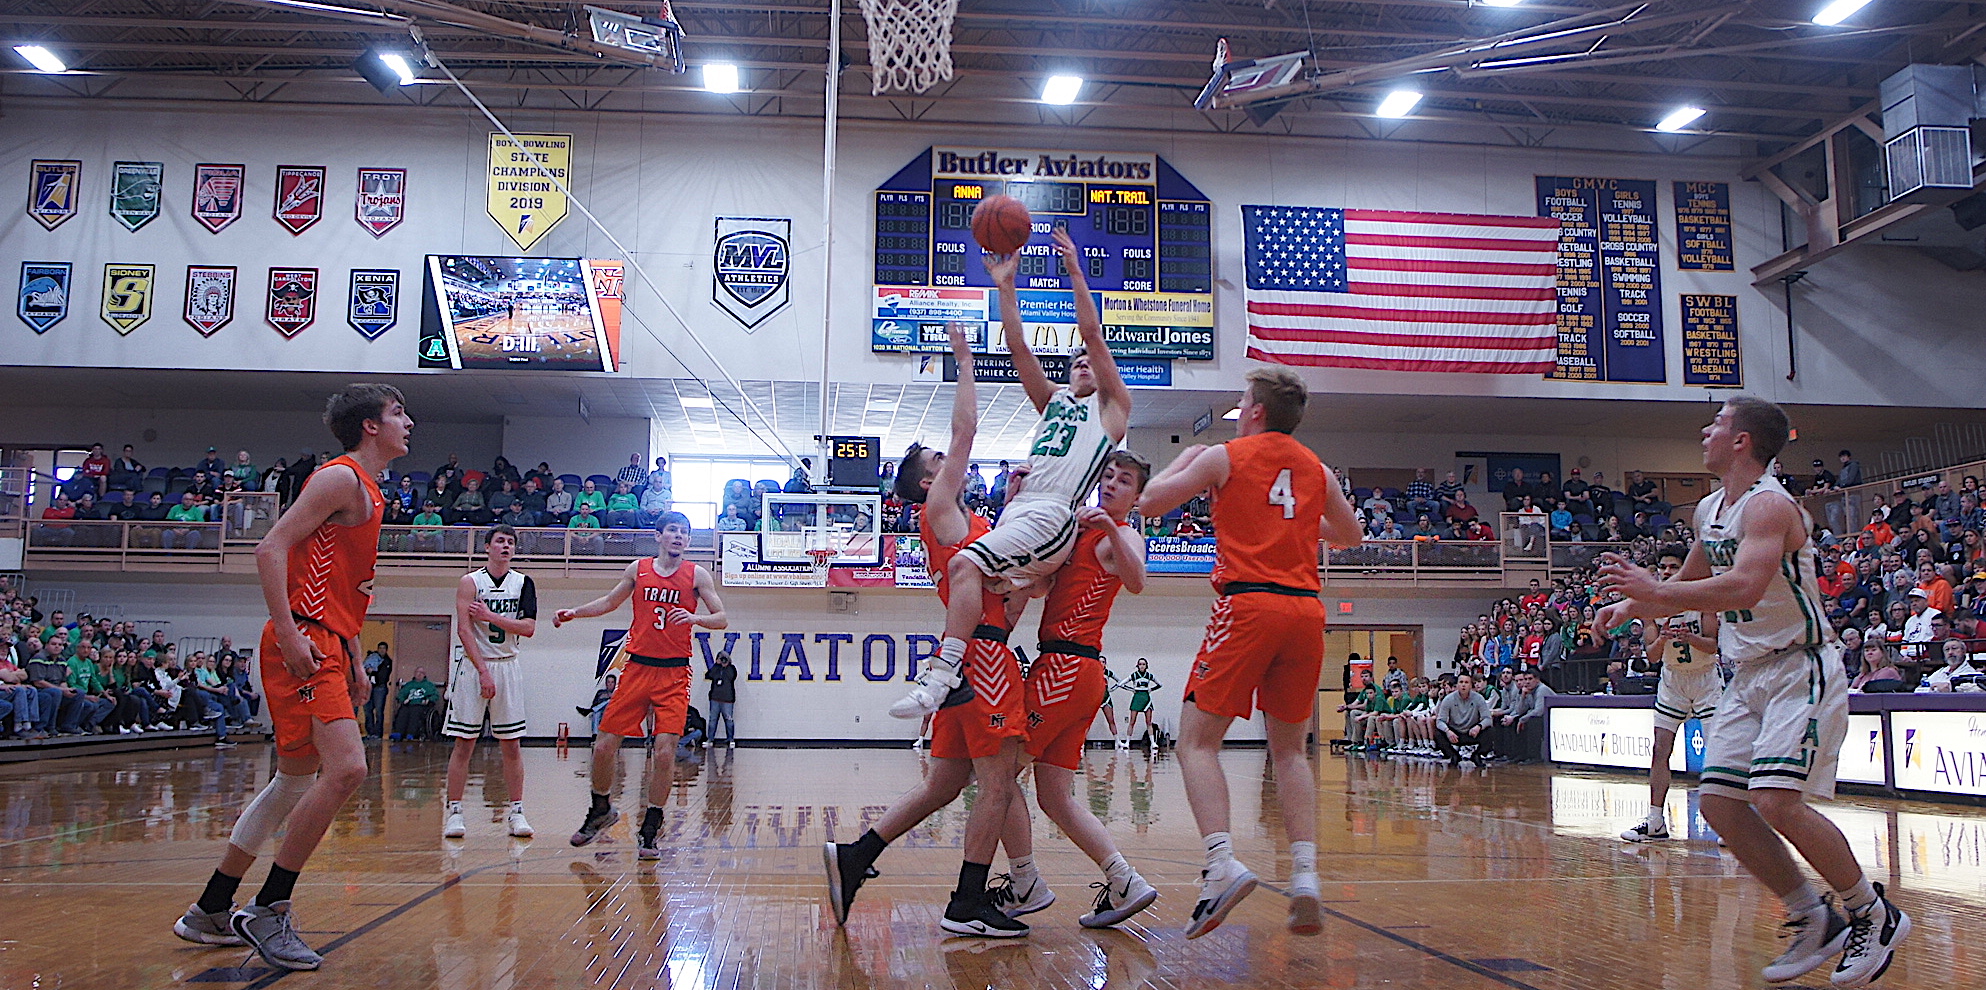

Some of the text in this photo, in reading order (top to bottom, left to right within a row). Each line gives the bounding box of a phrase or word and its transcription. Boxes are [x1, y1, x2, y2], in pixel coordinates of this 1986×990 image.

[524, 140, 566, 148] BOWLING
[938, 151, 1151, 179] Butler Aviators
[498, 182, 550, 192] DIVISION
[954, 185, 982, 199] ANNA
[1686, 183, 1716, 193] MCC
[1090, 190, 1149, 205] NAT.TRAIL
[1555, 189, 1578, 198] BOYS
[1615, 191, 1639, 200] GIRLS
[361, 193, 401, 207] Trojans
[510, 197, 543, 209] 2019
[914, 195, 925, 203] PTS
[1545, 197, 1588, 207] FOOTBALL
[1612, 199, 1642, 209] TENNIS
[1688, 199, 1717, 208] TENNIS
[1551, 212, 1583, 222] SOCCER
[1602, 213, 1653, 224] VOLLEYBALL
[1678, 215, 1729, 225] BASKETBALL
[1564, 228, 1597, 238] COUNTRY
[1558, 243, 1595, 253] KETBALL
[1601, 241, 1658, 252] CROSS COUNTRY
[1685, 239, 1727, 249] SOFTBALL
[720, 244, 784, 268] MVL
[936, 243, 965, 253] FOULS
[1084, 247, 1110, 258] T.O.L.
[1123, 249, 1151, 259] FOULS
[1557, 259, 1593, 268] ESTLING
[1604, 257, 1656, 268] BASKETBALL
[1681, 253, 1732, 264] VOLLEYBALL
[110, 269, 149, 277] SIDNEY
[356, 274, 394, 282] XENIA
[1612, 273, 1651, 283] SWIMMING
[724, 274, 779, 283] ATHLETICS
[936, 276, 1152, 290] SCORE MATCH SCORE
[1556, 287, 1588, 297] TENNIS
[1619, 289, 1647, 298] TRACK
[937, 300, 960, 308] Realty,
[1020, 299, 1076, 310] Premier Hea
[1104, 297, 1211, 313] Morton & Whetstone Funeral Home
[1685, 296, 1732, 308] SWBL
[909, 308, 926, 316] (937)
[1560, 304, 1584, 313] GOLF
[1689, 308, 1730, 317] FOOTBALL
[1020, 309, 1060, 319] Miami Valley
[1116, 313, 1135, 322] Serving
[1144, 314, 1173, 323] Community
[1617, 313, 1650, 323] SOCCER
[922, 325, 944, 334] WE
[1613, 329, 1656, 339] SOFTBALL
[1105, 325, 1212, 345] Edward Jones
[1558, 333, 1587, 343] TRACK
[1686, 330, 1736, 340] BASKETBALL
[427, 339, 446, 356] A
[1127, 347, 1156, 355] Individual
[1157, 348, 1182, 356] Investors
[1183, 348, 1198, 356] Since
[1685, 348, 1737, 358] WRESTLING
[1557, 356, 1597, 367] ASEBALL
[1136, 365, 1164, 374] Health
[1692, 364, 1733, 374] BASEBALL
[1030, 422, 1077, 457] 23
[837, 443, 868, 458] 25:6
[1268, 468, 1296, 519] 4
[747, 563, 772, 572] ALUMNI
[724, 572, 738, 580] Sign
[644, 587, 680, 604] TRAIL
[653, 606, 666, 630] 3
[1530, 643, 1540, 658] 2
[1673, 641, 1692, 663] 3
[1801, 718, 1819, 747] A
[1553, 731, 1652, 757] VANDALIA BUTLER
